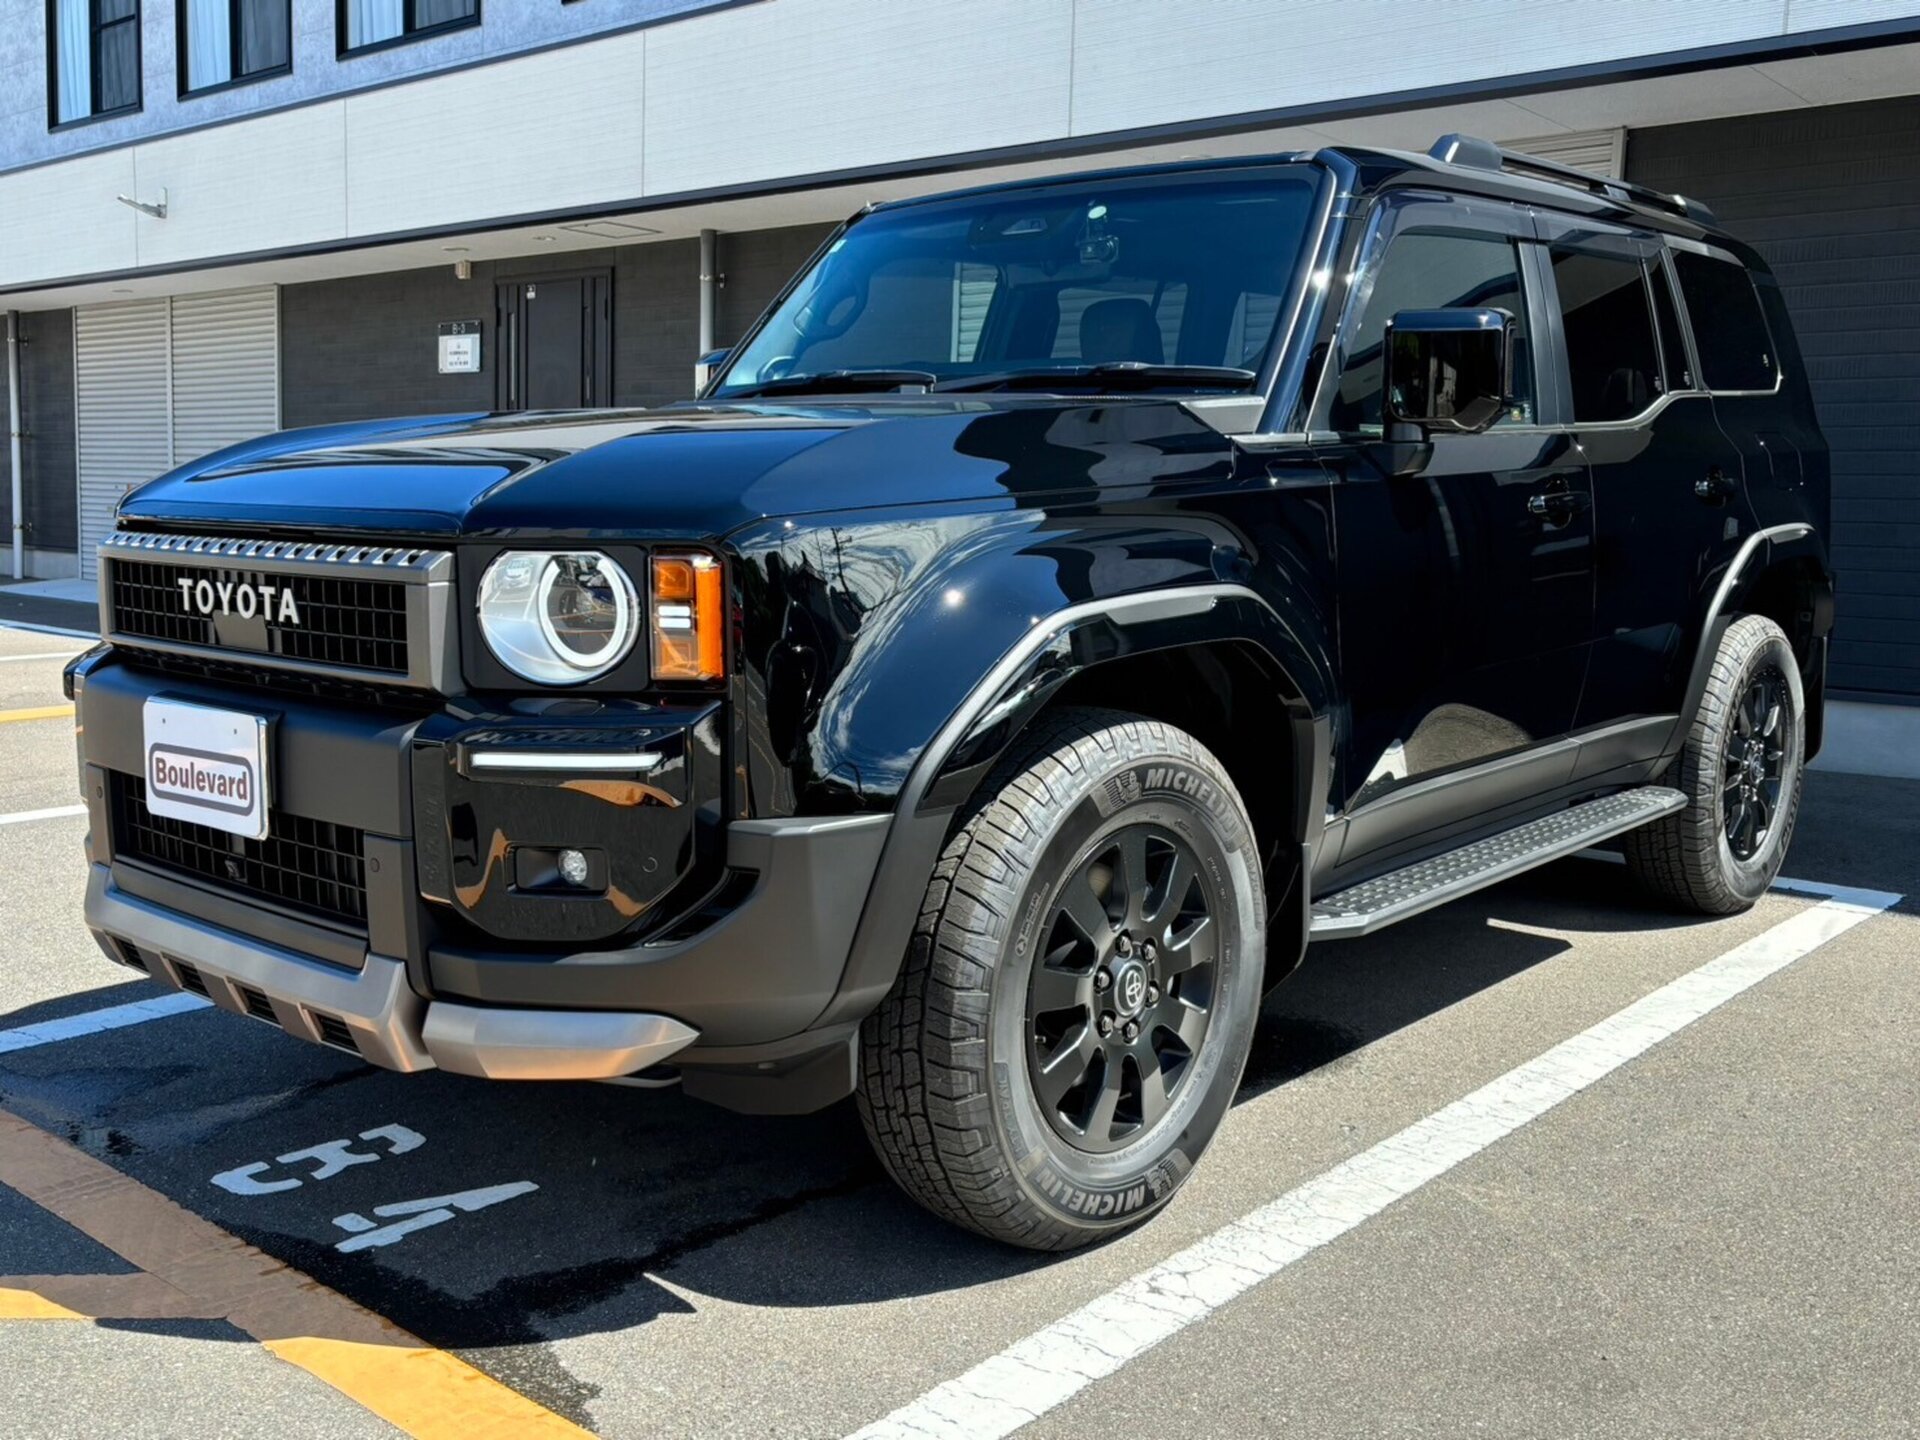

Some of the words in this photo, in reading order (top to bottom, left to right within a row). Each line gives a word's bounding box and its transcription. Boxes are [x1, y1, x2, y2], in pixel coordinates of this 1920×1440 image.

[178, 578, 300, 625] TOYOTA
[155, 757, 249, 801] Boulevard
[1144, 767, 1240, 840] MICHELIN
[1035, 1166, 1146, 1217] MICHELIN
